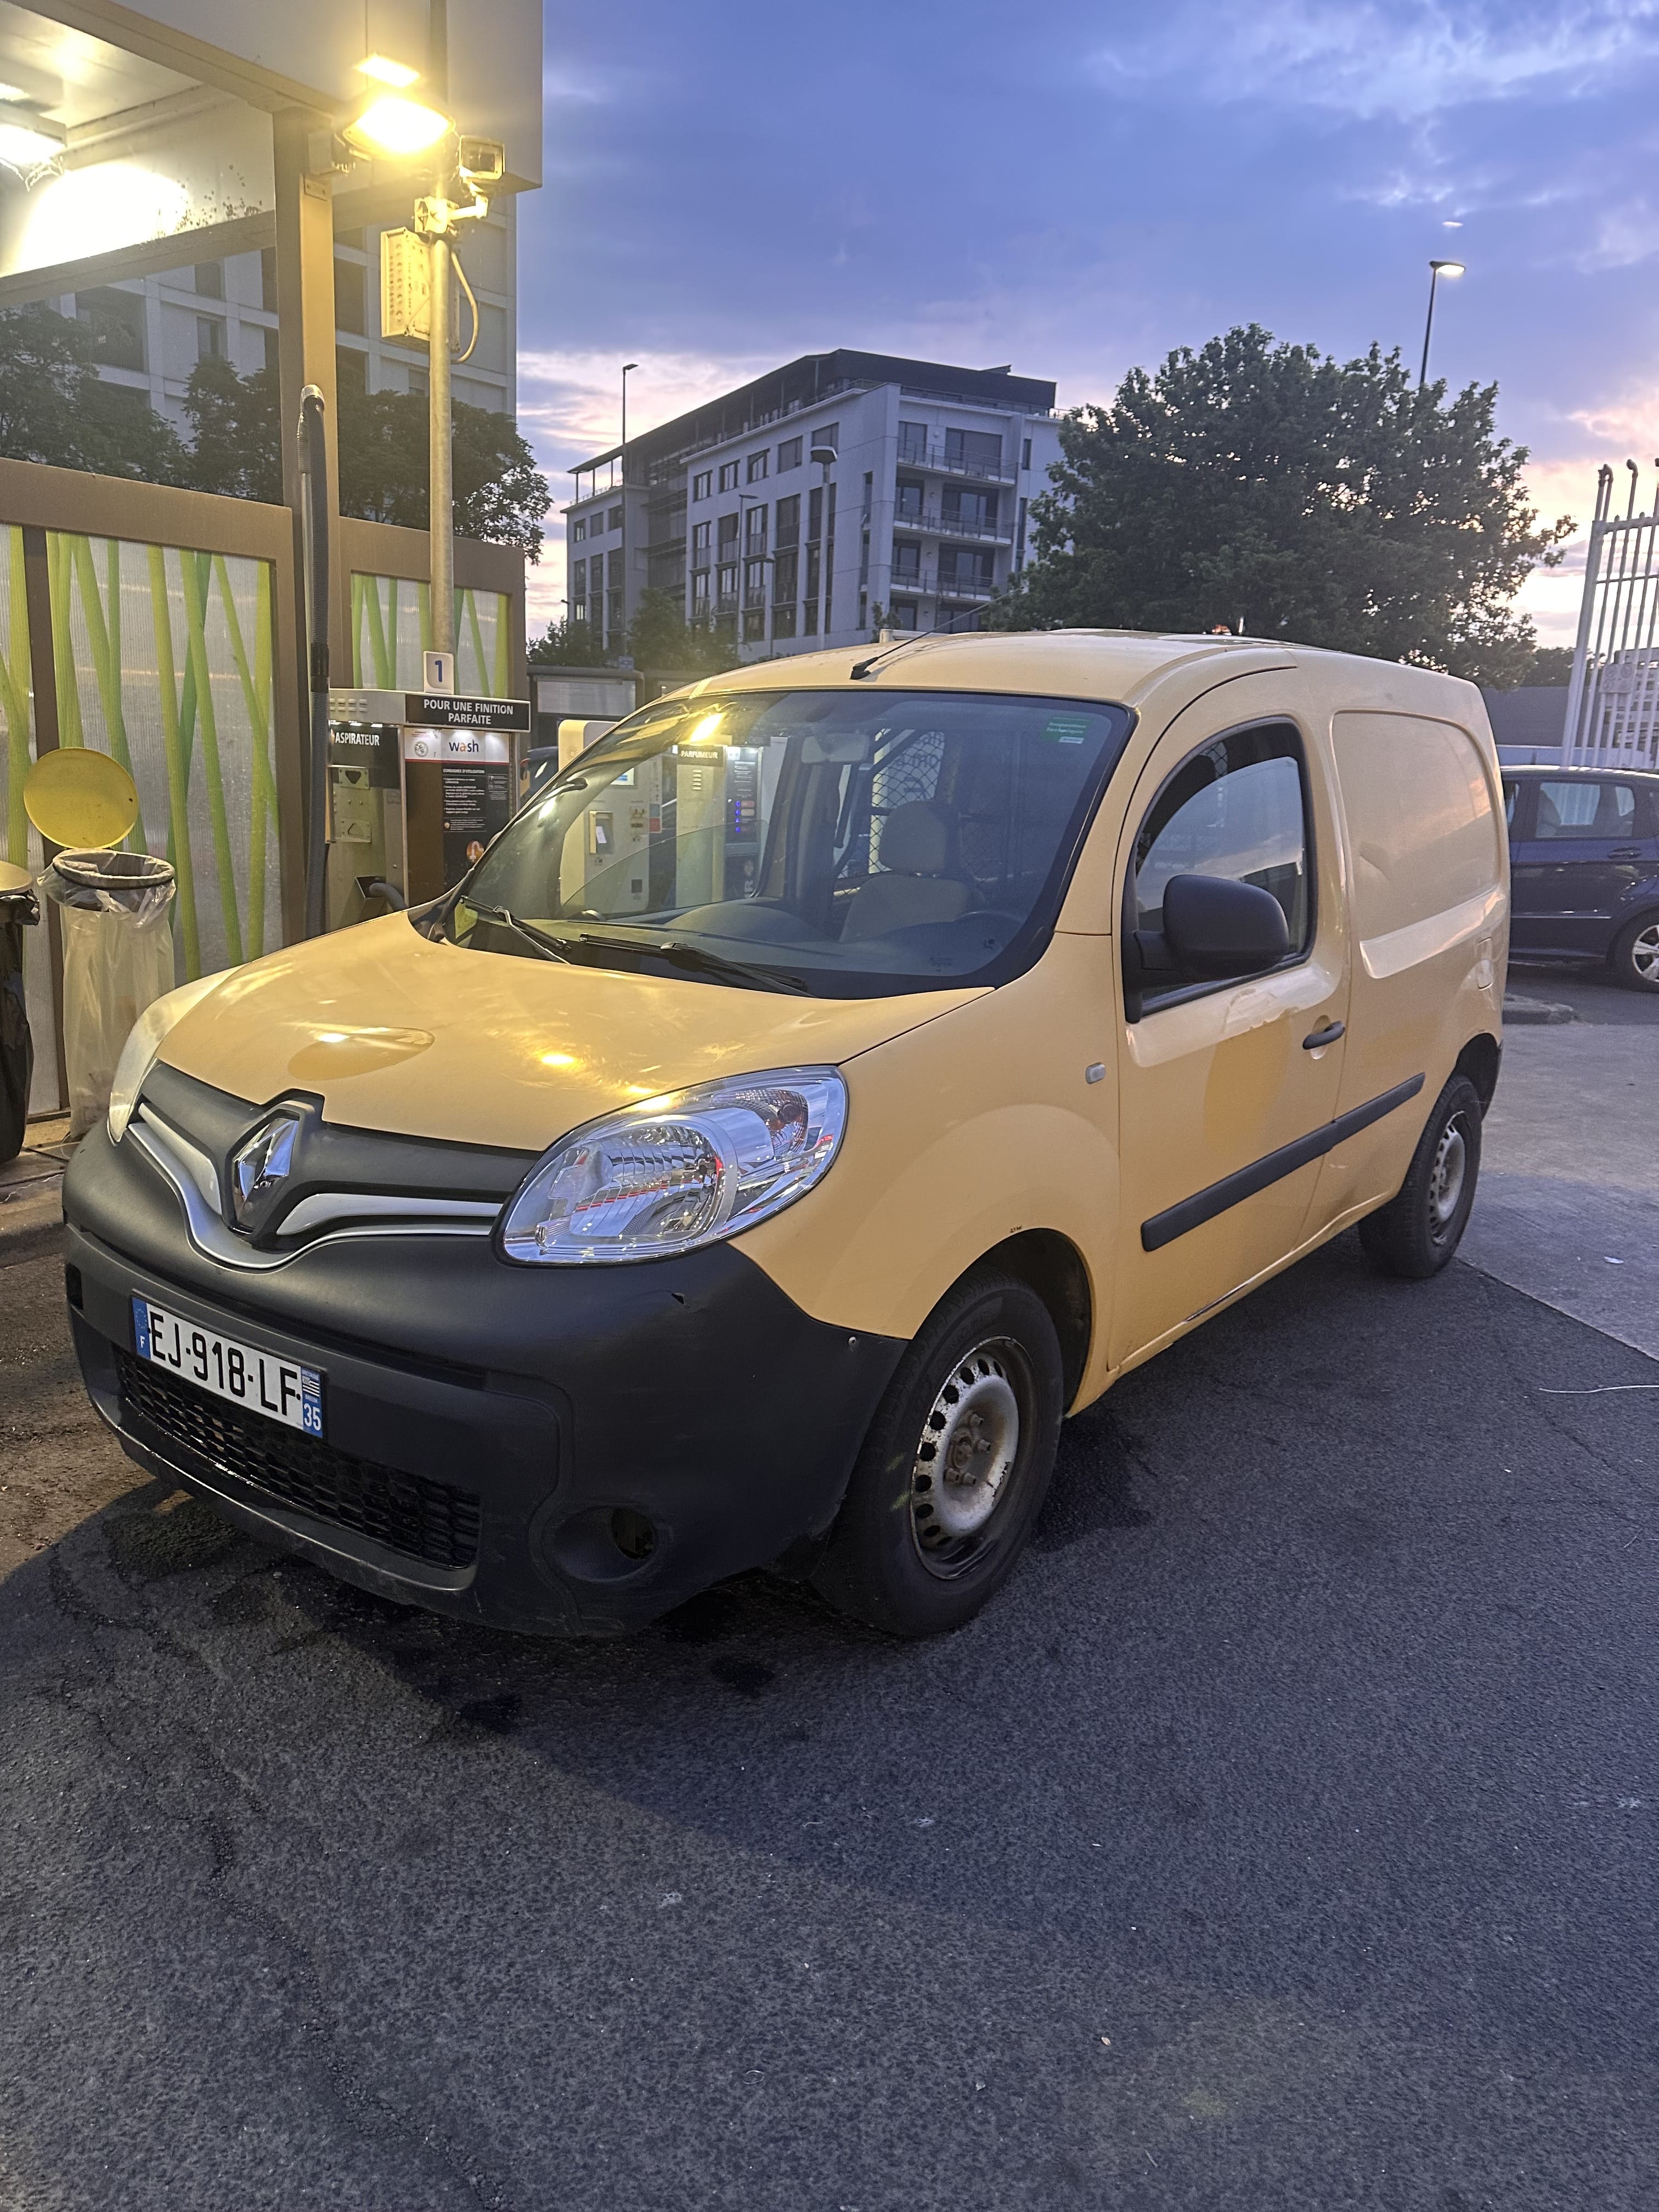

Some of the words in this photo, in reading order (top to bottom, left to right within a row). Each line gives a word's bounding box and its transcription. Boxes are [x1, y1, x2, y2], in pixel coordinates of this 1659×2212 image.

[435, 660, 443, 683] 1
[424, 699, 450, 710] POUR
[453, 701, 472, 712] UNE
[475, 703, 514, 715] FINITION
[448, 713, 492, 725] PARFAITE
[335, 732, 380, 746] ASPIRATEUR
[680, 750, 719, 759] PARFUMEUR
[140, 1335, 145, 1348] F
[150, 1311, 297, 1416] EJ-918-LF
[303, 1403, 321, 1431] 35
